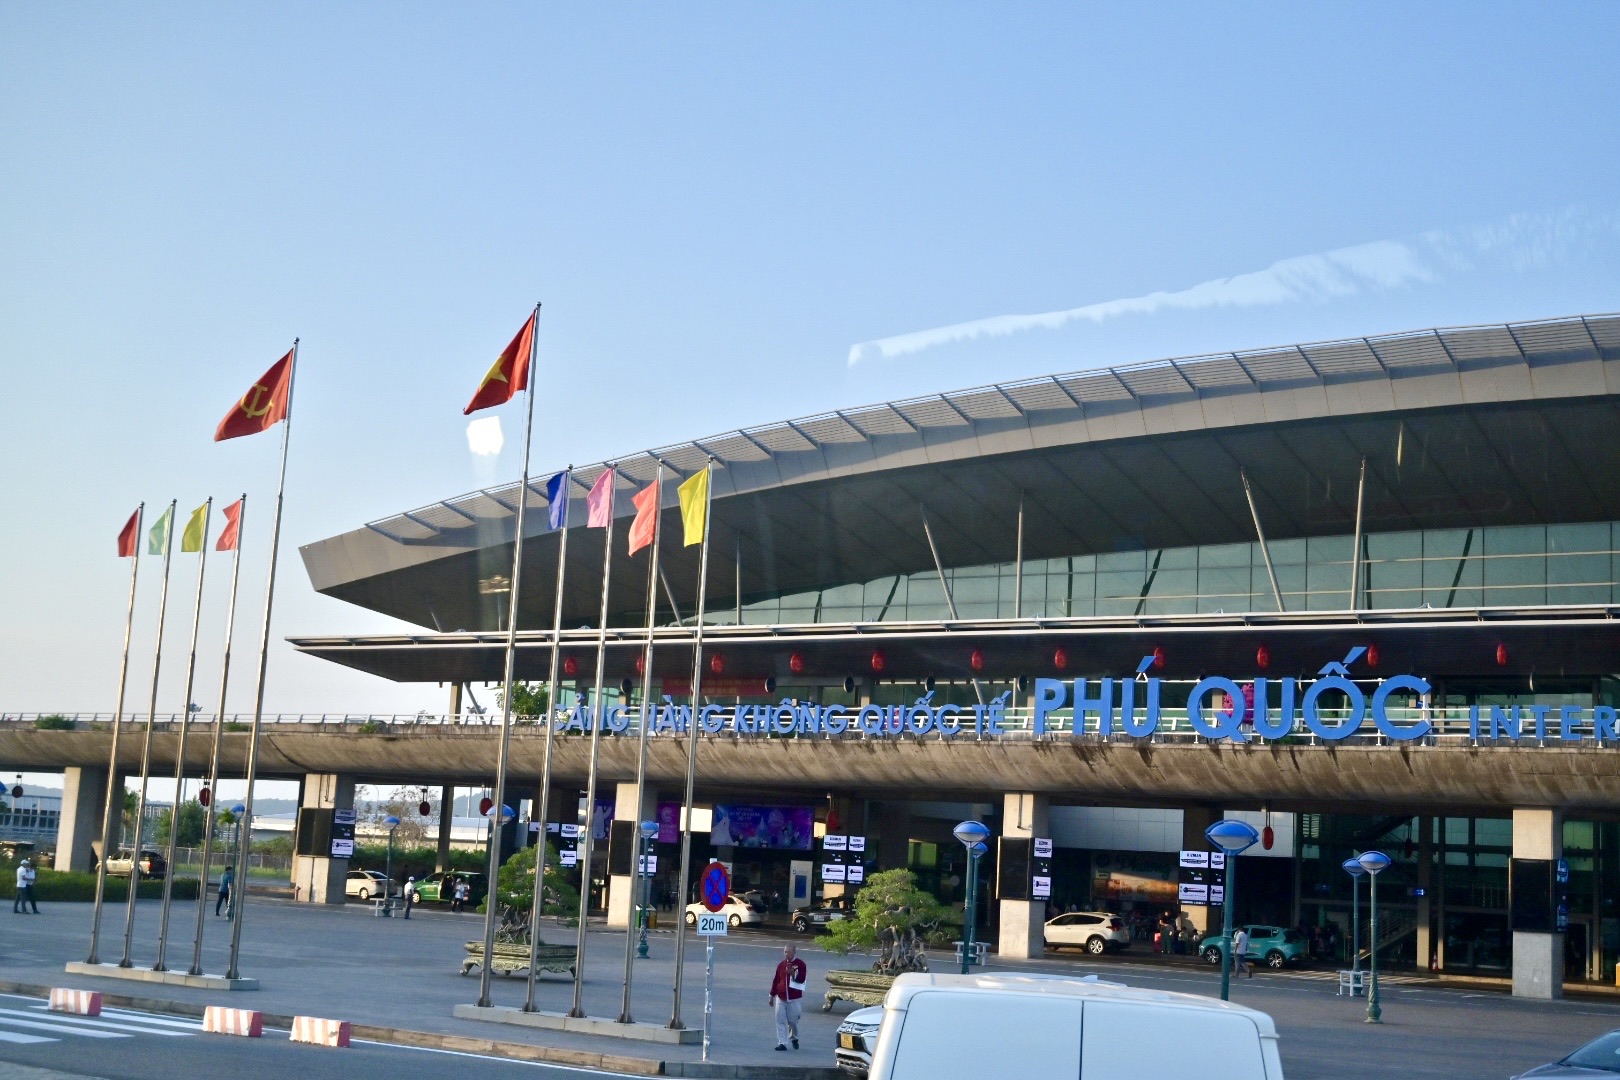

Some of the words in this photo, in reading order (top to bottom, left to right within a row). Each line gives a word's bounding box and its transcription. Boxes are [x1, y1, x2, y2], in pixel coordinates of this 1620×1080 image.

[733, 697, 849, 735] KHÔNG
[858, 690, 962, 736] QUỐC
[971, 690, 1012, 735] TẾ
[1033, 655, 1161, 738] PHÚ
[1186, 646, 1432, 743] QUỐC
[1469, 704, 1618, 741] INTER
[701, 918, 724, 931] 20m
